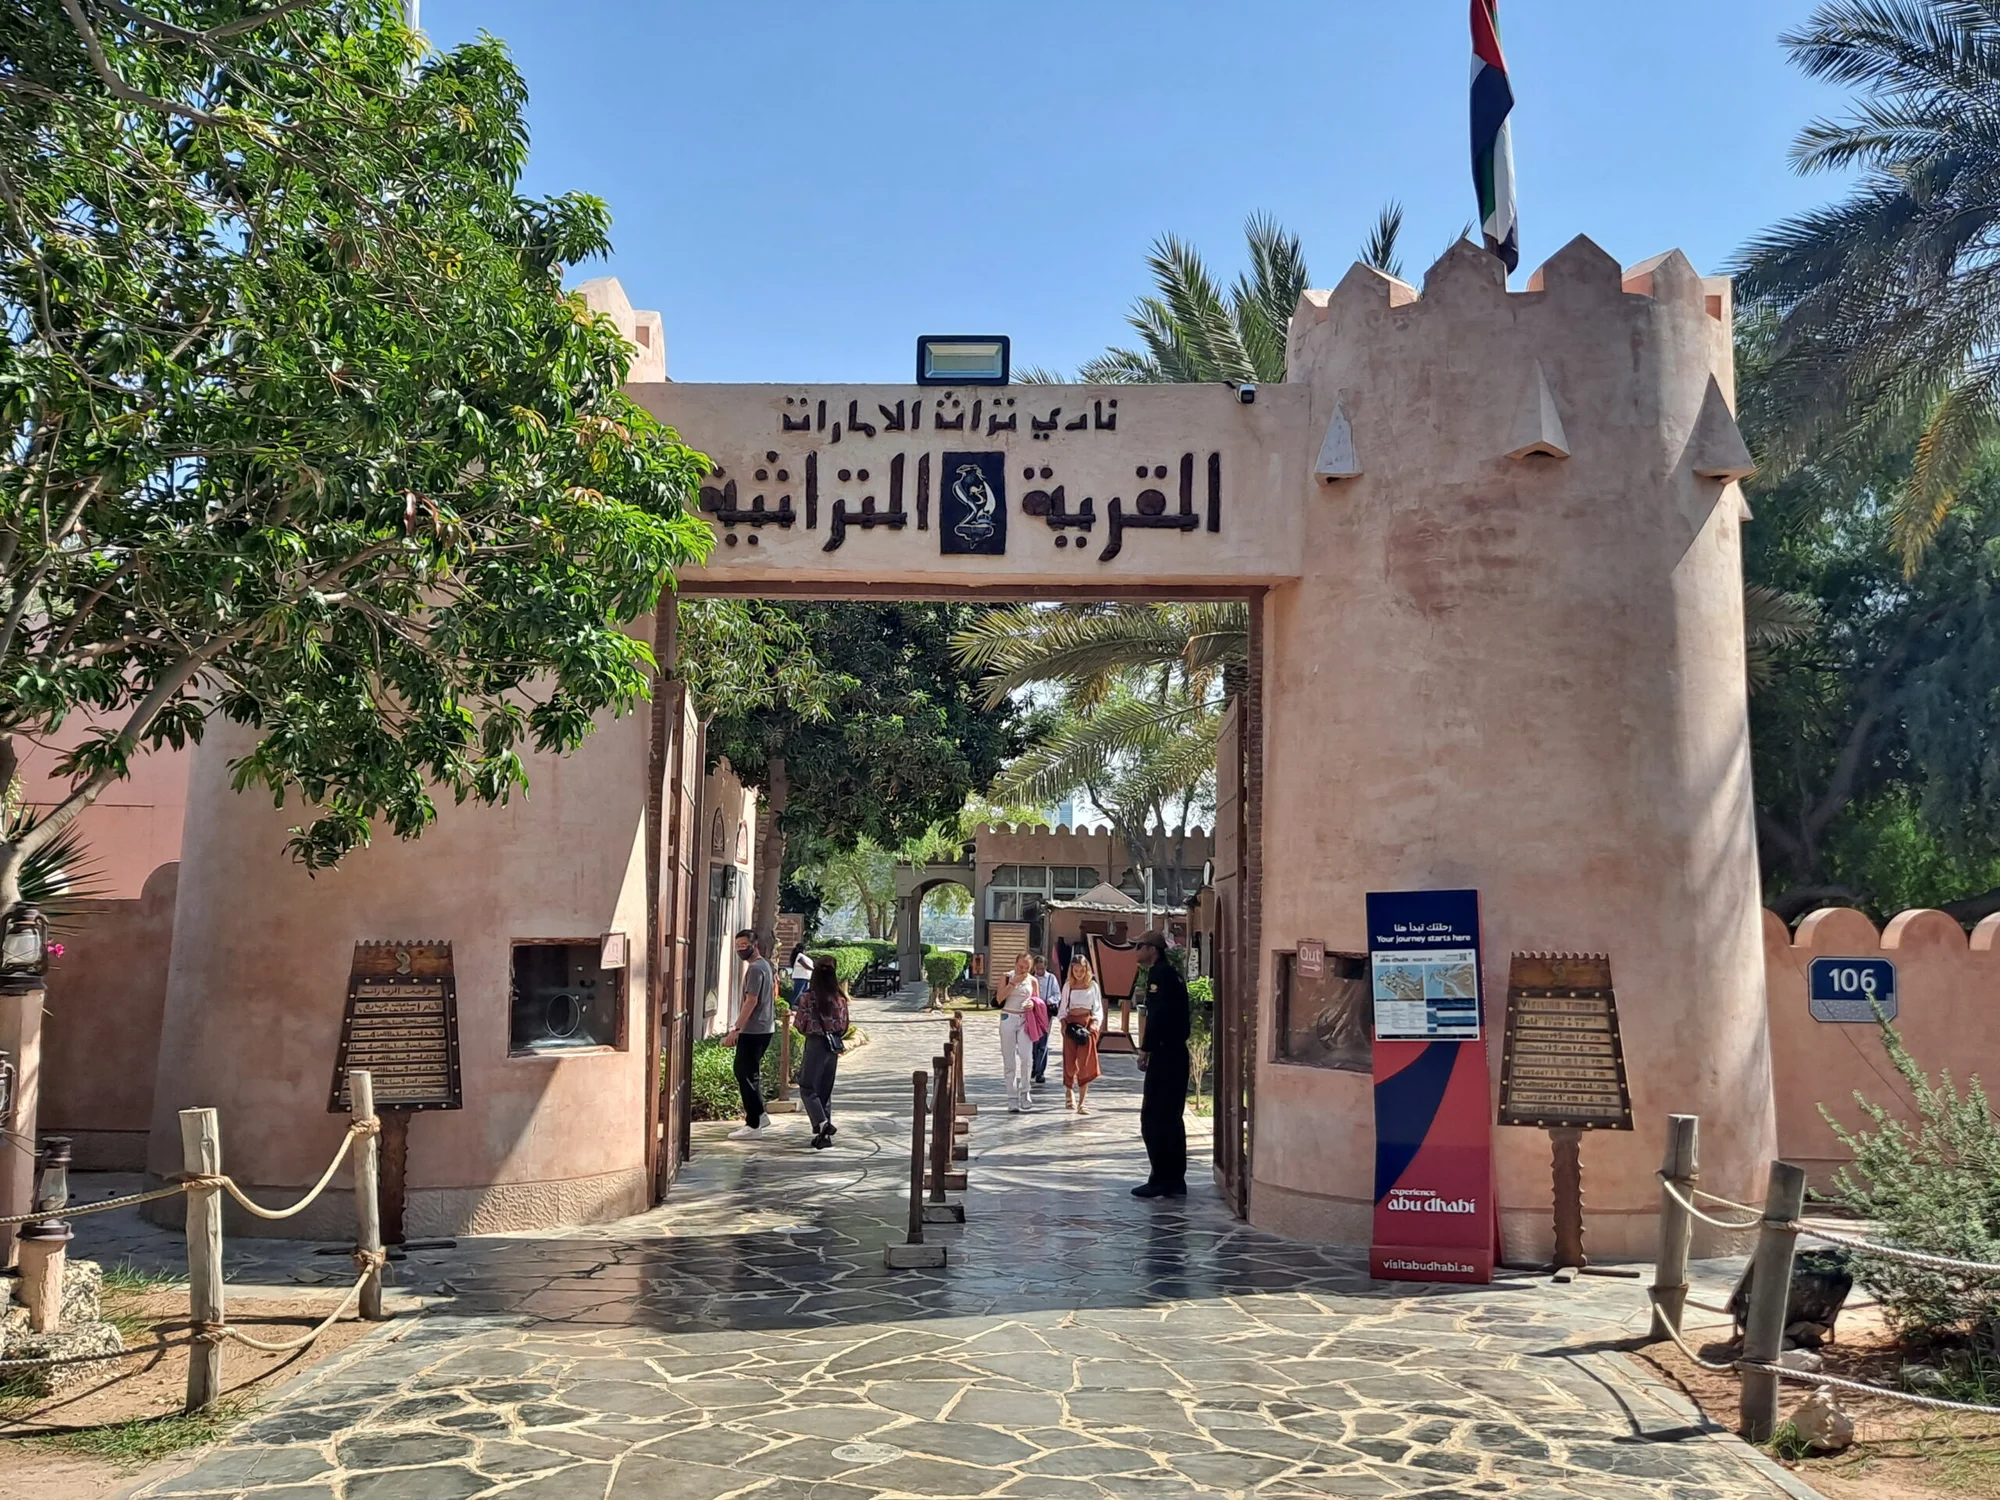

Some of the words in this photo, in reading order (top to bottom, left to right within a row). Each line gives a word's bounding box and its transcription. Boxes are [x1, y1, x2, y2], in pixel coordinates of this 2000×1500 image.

[935, 390, 1016, 437] تراث
[1031, 397, 1118, 440] نادي
[699, 450, 930, 552] التراثية
[1021, 452, 1220, 562] القرية
[1393, 923, 1407, 932] هنا
[1426, 923, 1452, 933] رحلتك
[1376, 935, 1394, 943] Your
[1396, 935, 1426, 944] journey
[1427, 934, 1451, 942] starts
[1300, 946, 1320, 962] Out
[1828, 968, 1876, 992] 106
[1390, 1188, 1436, 1196] experience
[1387, 1197, 1420, 1211] abu
[1424, 1198, 1475, 1213] dhabi
[1383, 1259, 1475, 1273] visitabudhabi.ae
